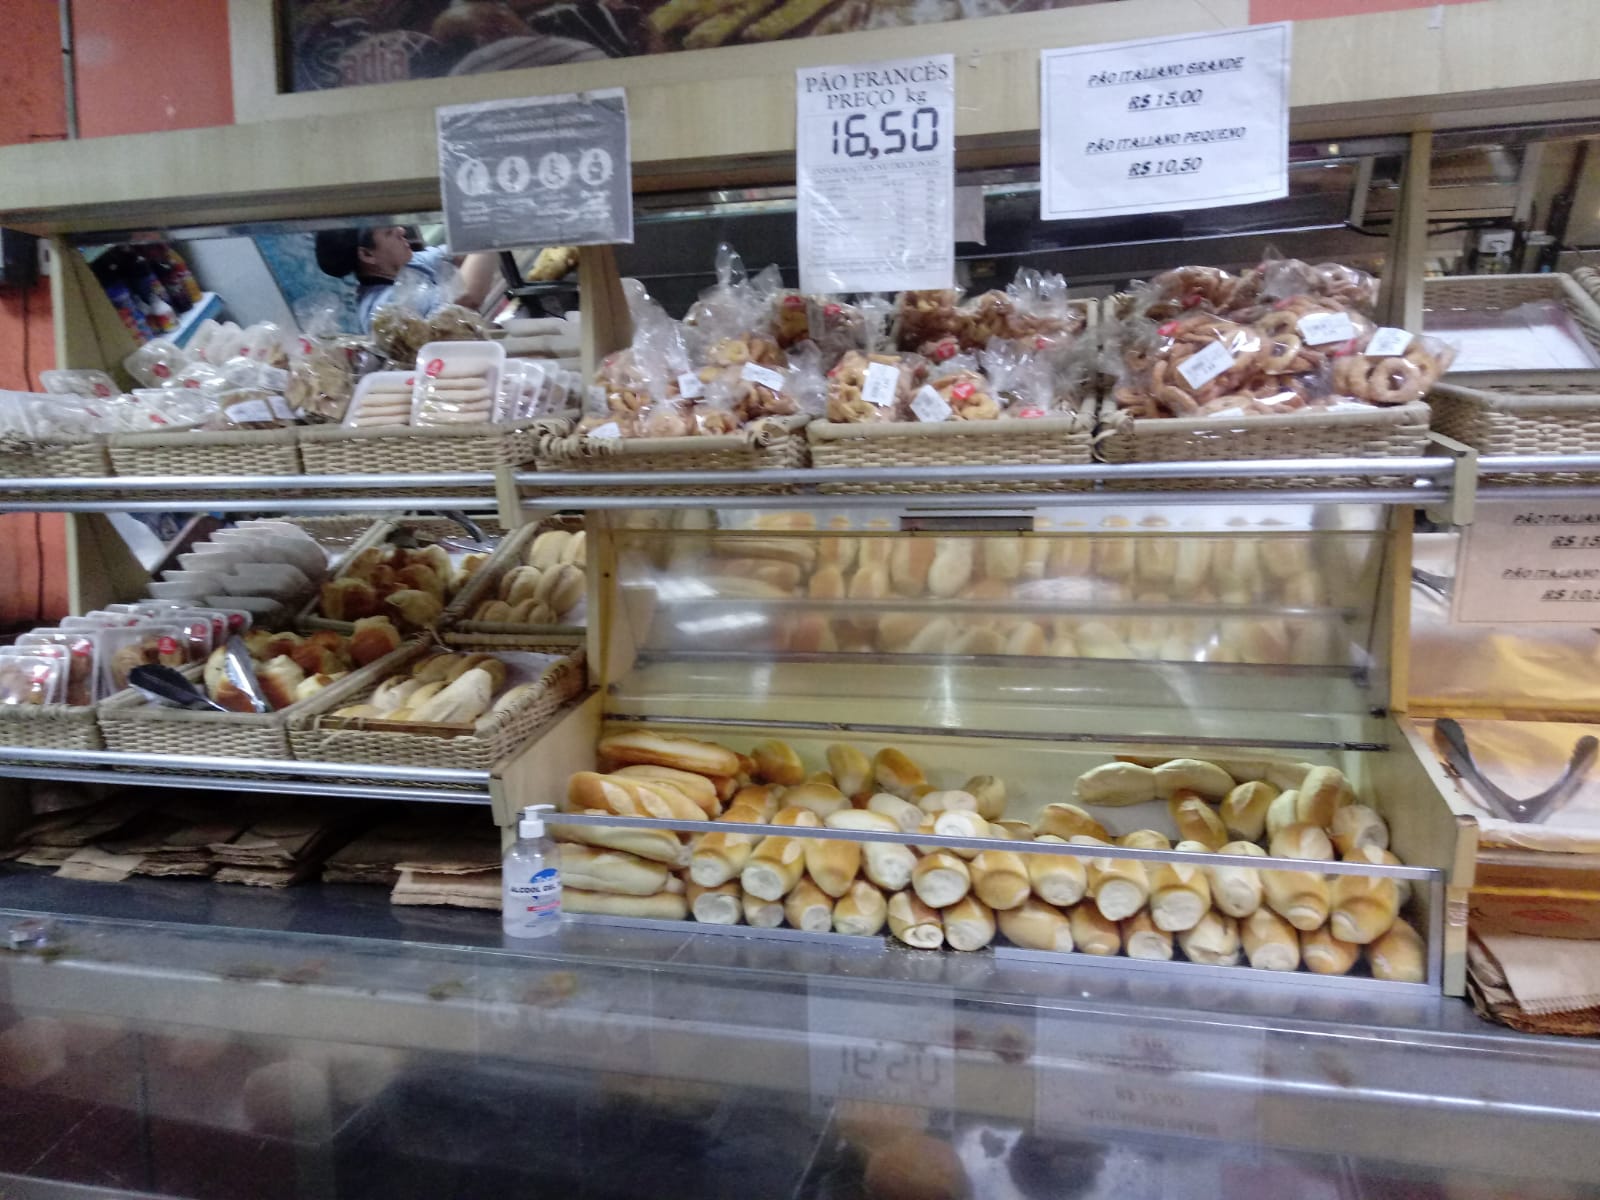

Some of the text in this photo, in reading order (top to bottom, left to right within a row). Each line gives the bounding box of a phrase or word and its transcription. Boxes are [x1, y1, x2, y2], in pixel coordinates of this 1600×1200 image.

[806, 61, 949, 92] PÃO FRANCÊS
[1088, 56, 1245, 86] PÃO ITALIANO GRANDE
[828, 87, 927, 109] PREÇO kg
[1156, 89, 1203, 107] 15,00
[833, 107, 939, 159] 16,50
[1086, 126, 1246, 153] PÃO ITALIANO PEQUENO
[1156, 157, 1203, 174] 10,50
